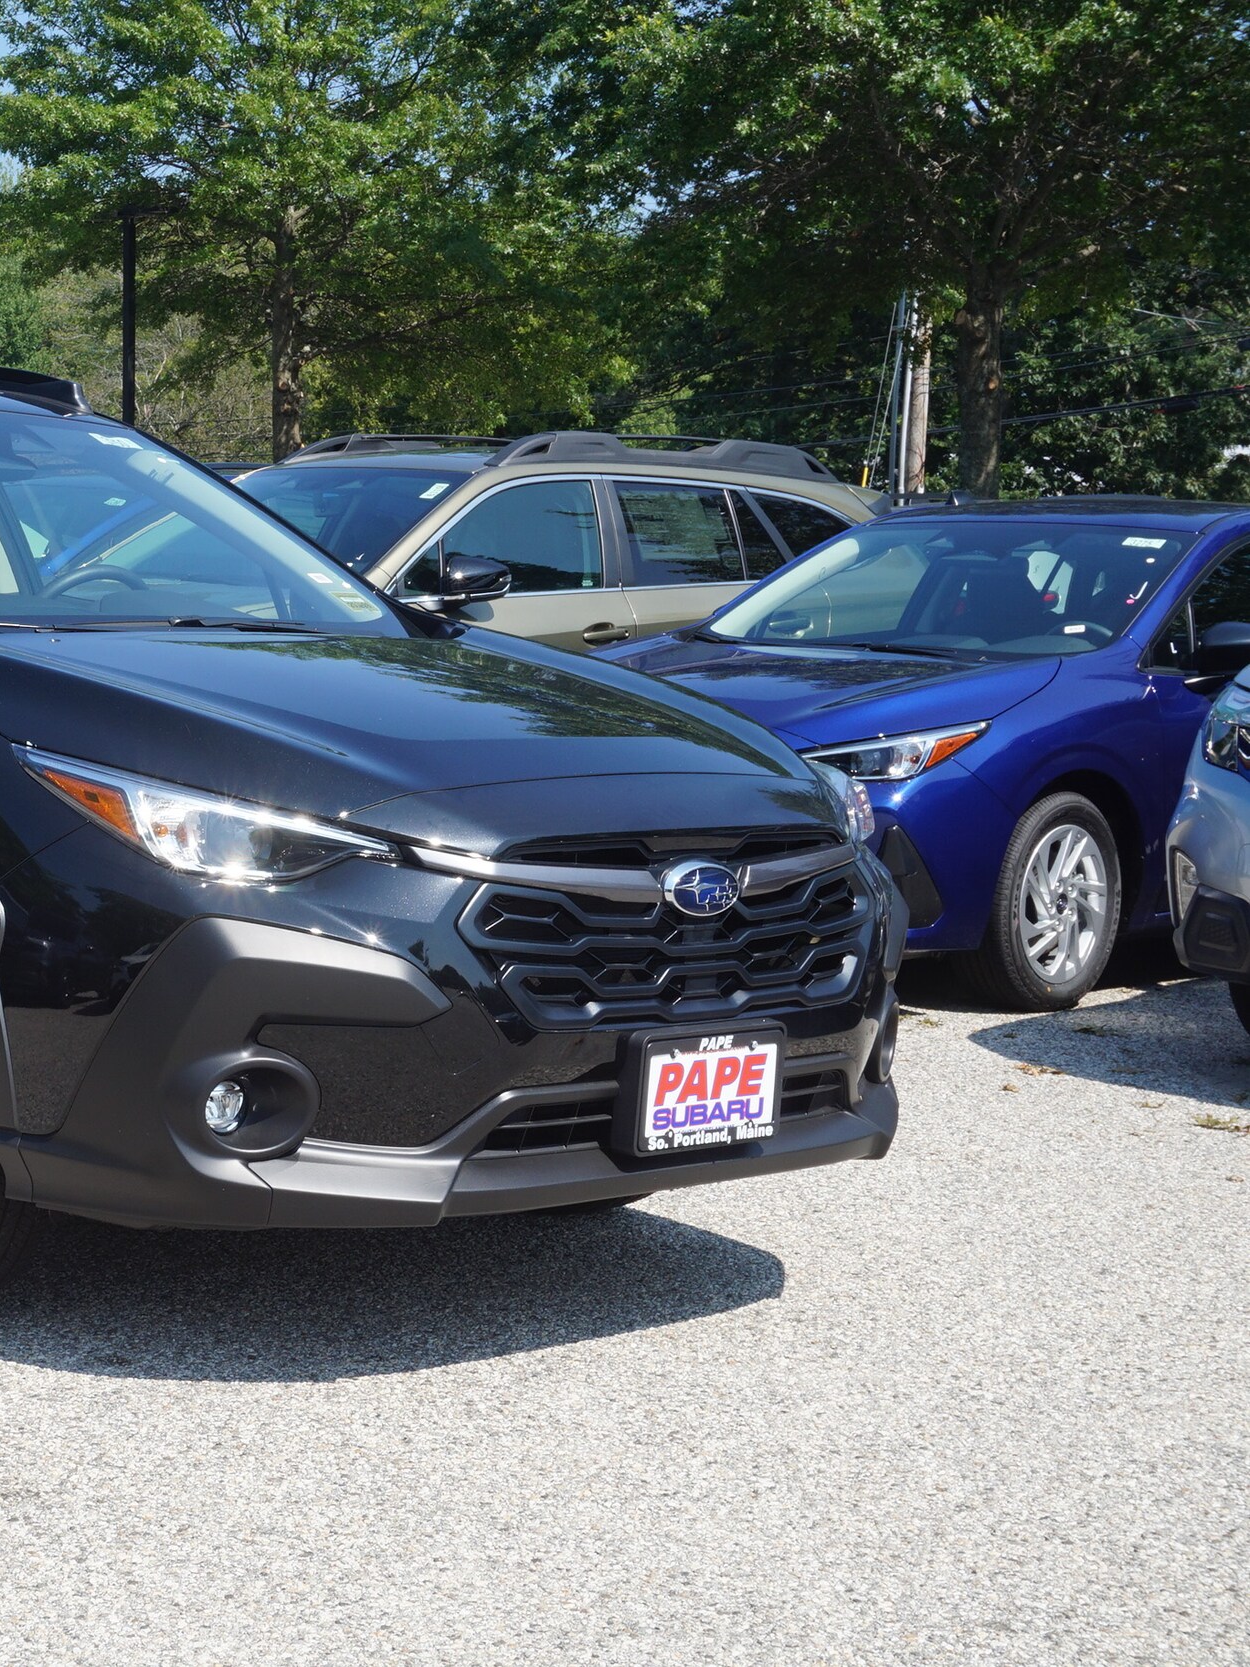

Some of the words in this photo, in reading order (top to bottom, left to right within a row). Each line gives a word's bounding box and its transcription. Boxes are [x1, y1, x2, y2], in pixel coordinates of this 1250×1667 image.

[699, 1035, 734, 1051] PAPE
[654, 1053, 768, 1107] PAPE
[652, 1097, 764, 1131] SUBARU
[648, 1136, 668, 1151] So.
[674, 1128, 732, 1148] Portland,
[736, 1122, 774, 1141] Maine
